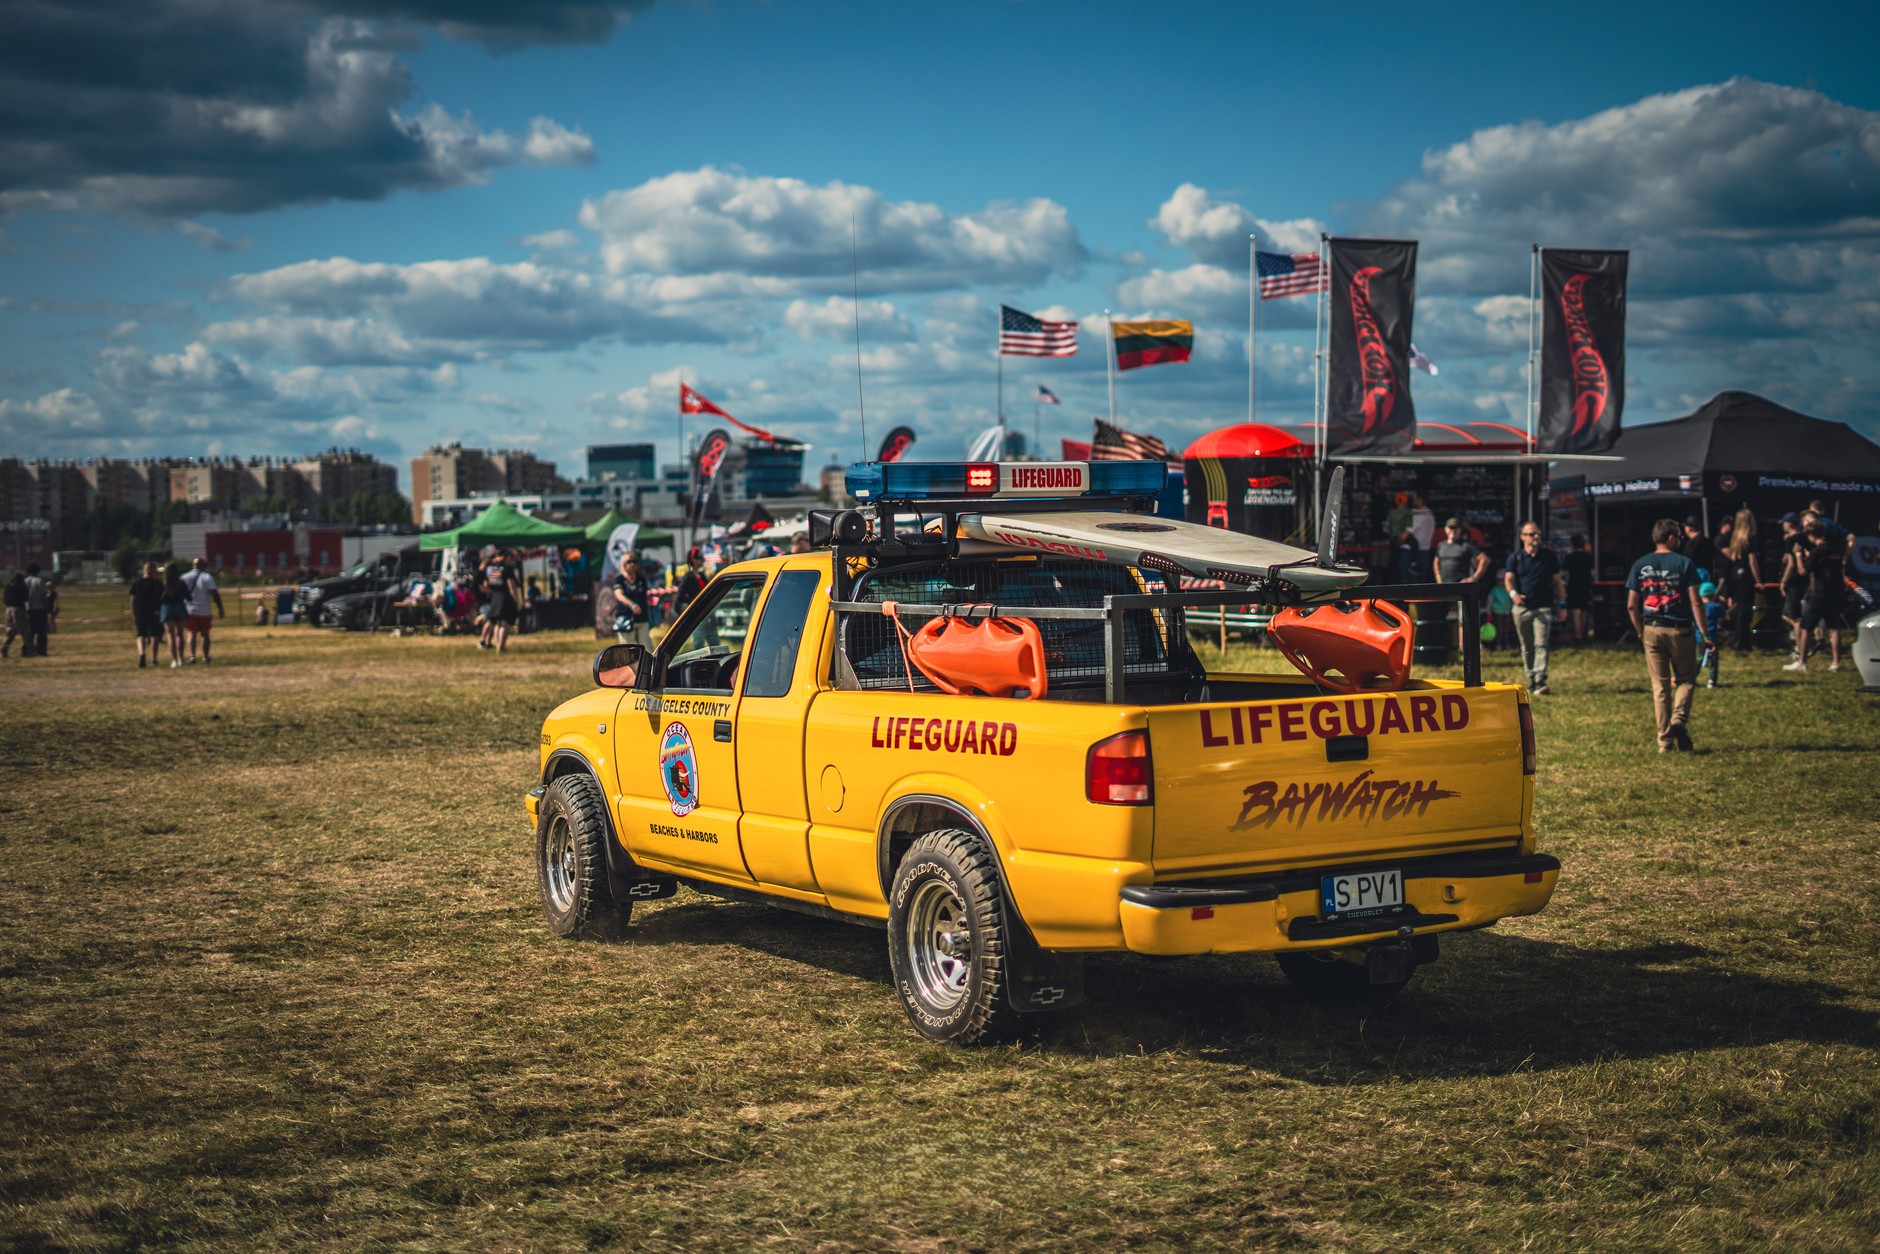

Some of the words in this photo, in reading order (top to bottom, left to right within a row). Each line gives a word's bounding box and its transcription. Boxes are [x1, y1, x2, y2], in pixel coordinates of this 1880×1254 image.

[1364, 347, 1393, 395] HOT
[1576, 352, 1606, 397] HOT
[1012, 468, 1082, 488] LIFEGUARD
[1614, 482, 1623, 494] in
[1759, 476, 1807, 488] Premium
[1808, 479, 1828, 490] Oils
[1830, 481, 1861, 491] made
[1862, 482, 1873, 492] in
[1243, 495, 1297, 505] LEGENDARY
[634, 698, 649, 711] LOS
[651, 699, 691, 714] ANGELES
[692, 701, 730, 717] COUNTY
[1199, 694, 1470, 748] LIFEGUARD
[666, 724, 687, 739] OCEAN
[872, 717, 1017, 756] LIFEGUARD
[1228, 770, 1461, 832] BAYWATCH
[650, 823, 679, 838] BEACHES
[680, 828, 686, 839] &
[686, 829, 719, 844] HARBORS
[897, 862, 967, 913] GOODYEAR
[1335, 879, 1351, 908] S
[1357, 873, 1397, 906] PV1
[1325, 898, 1334, 907] PL
[1347, 908, 1384, 919] CHEVROLET
